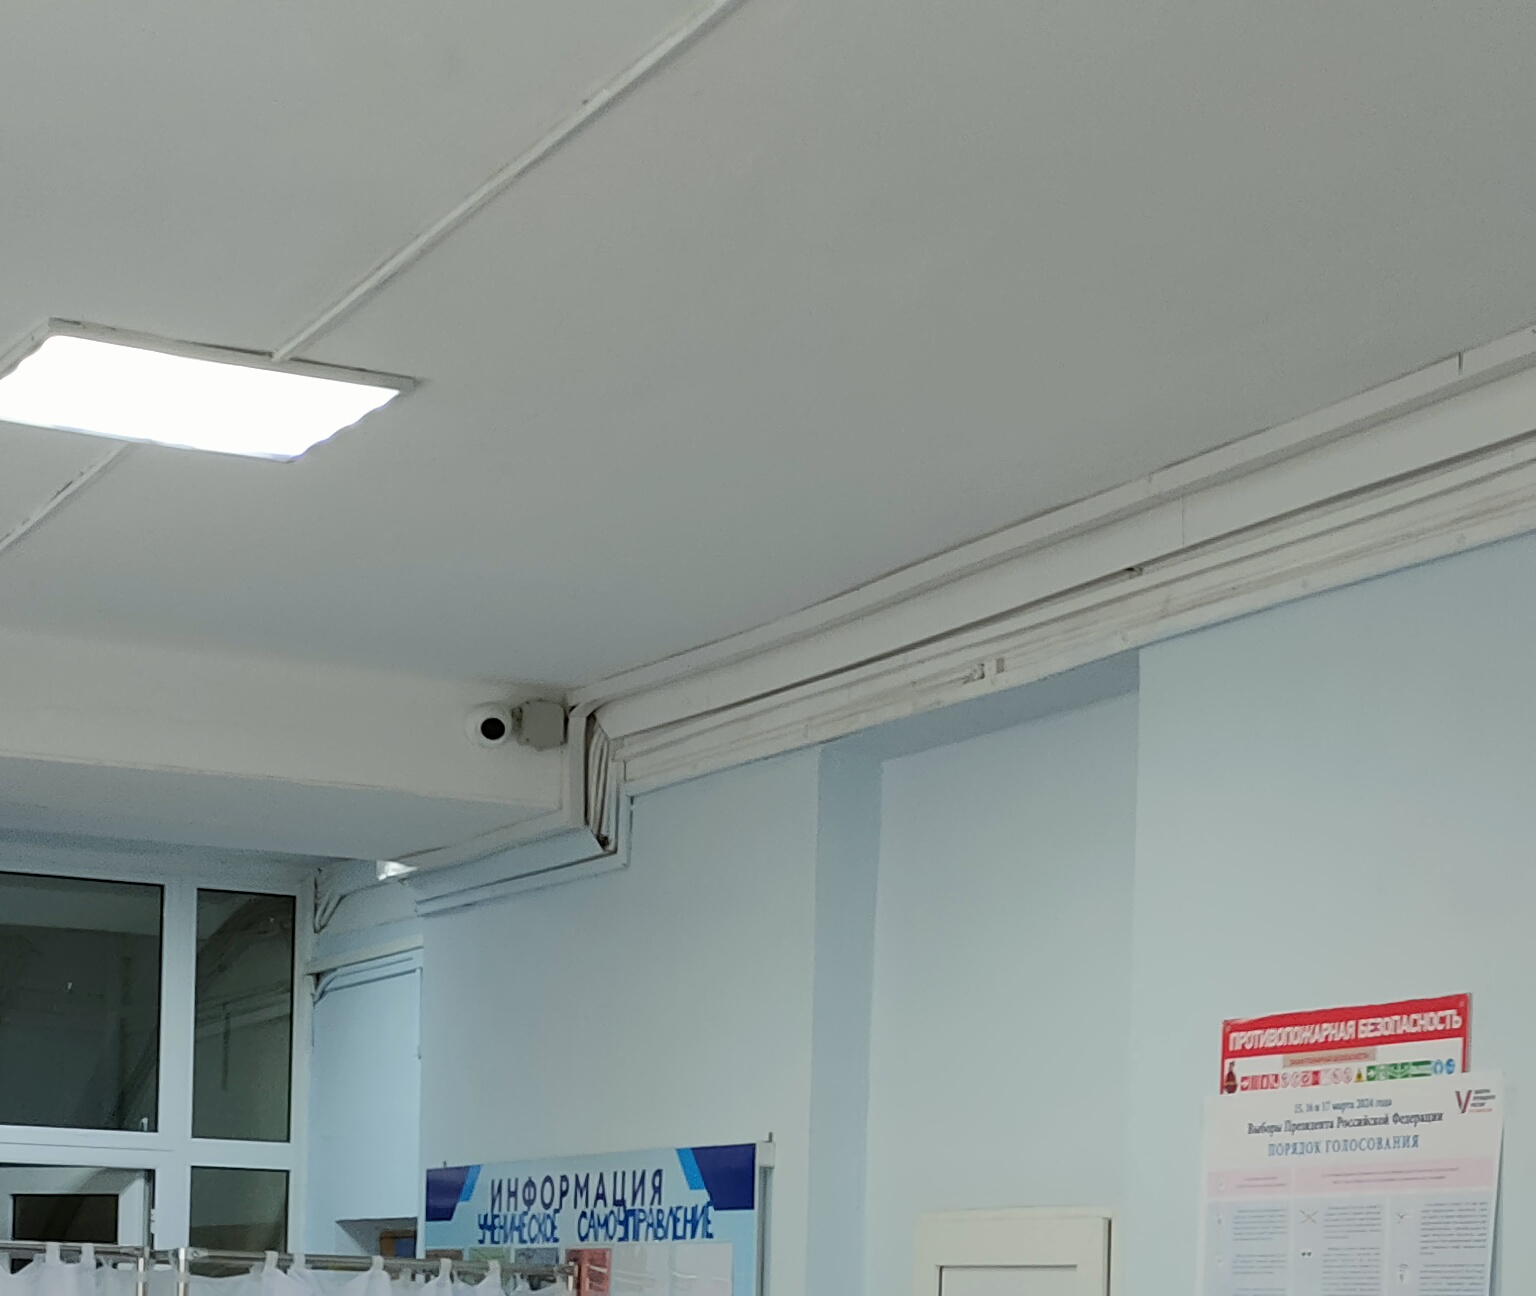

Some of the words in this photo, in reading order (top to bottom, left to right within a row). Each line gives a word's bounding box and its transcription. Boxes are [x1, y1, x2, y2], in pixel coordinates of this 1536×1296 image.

[1227, 1019, 1357, 1052] ПРОТИВОПОЖАРНАЯ
[1357, 1008, 1463, 1040] БЕЗОПАСНОСТЬ
[1321, 1101, 1331, 1112] 17
[1331, 1101, 1355, 1113] марта
[1356, 1098, 1374, 1109] 2024
[1247, 1121, 1283, 1137] Выборы
[1284, 1119, 1334, 1136] Президента
[1336, 1113, 1389, 1129] Российской
[1392, 1111, 1444, 1127] Федерации
[1267, 1139, 1321, 1157] ПОРЯДОК
[1325, 1134, 1420, 1153] ГОЛОСОВАНИЯ
[490, 1168, 664, 1213] ИНФОРМАЦИЯ
[576, 1200, 715, 1243] САМОУПРАВЛЕНИЕ
